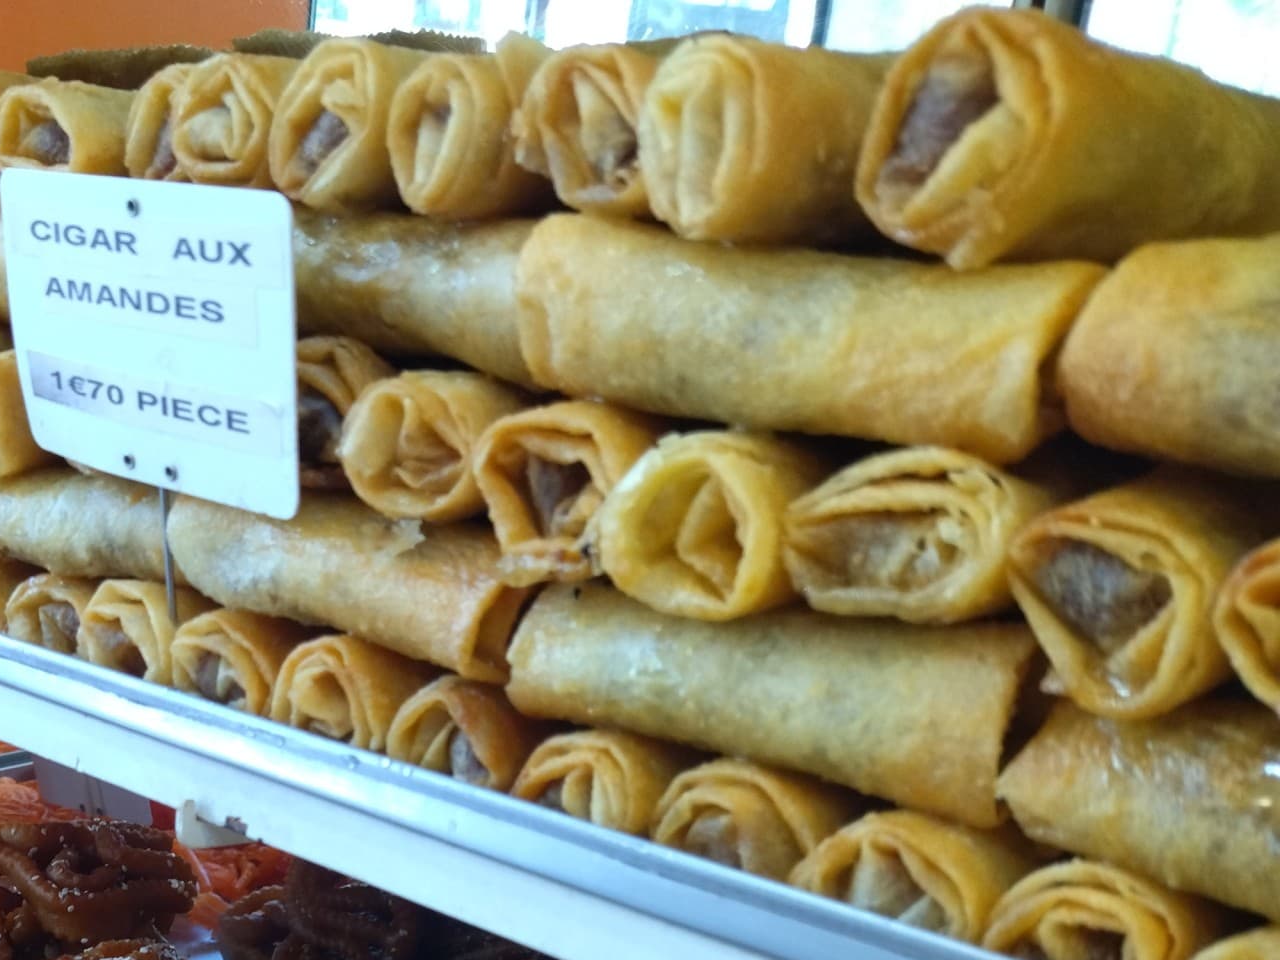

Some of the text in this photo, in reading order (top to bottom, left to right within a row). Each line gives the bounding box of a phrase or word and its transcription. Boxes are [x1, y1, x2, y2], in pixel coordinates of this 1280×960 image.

[30, 219, 253, 267] CIGAR AUX
[45, 276, 226, 324] AMANDES
[50, 370, 251, 435] 1€70 PIECE
